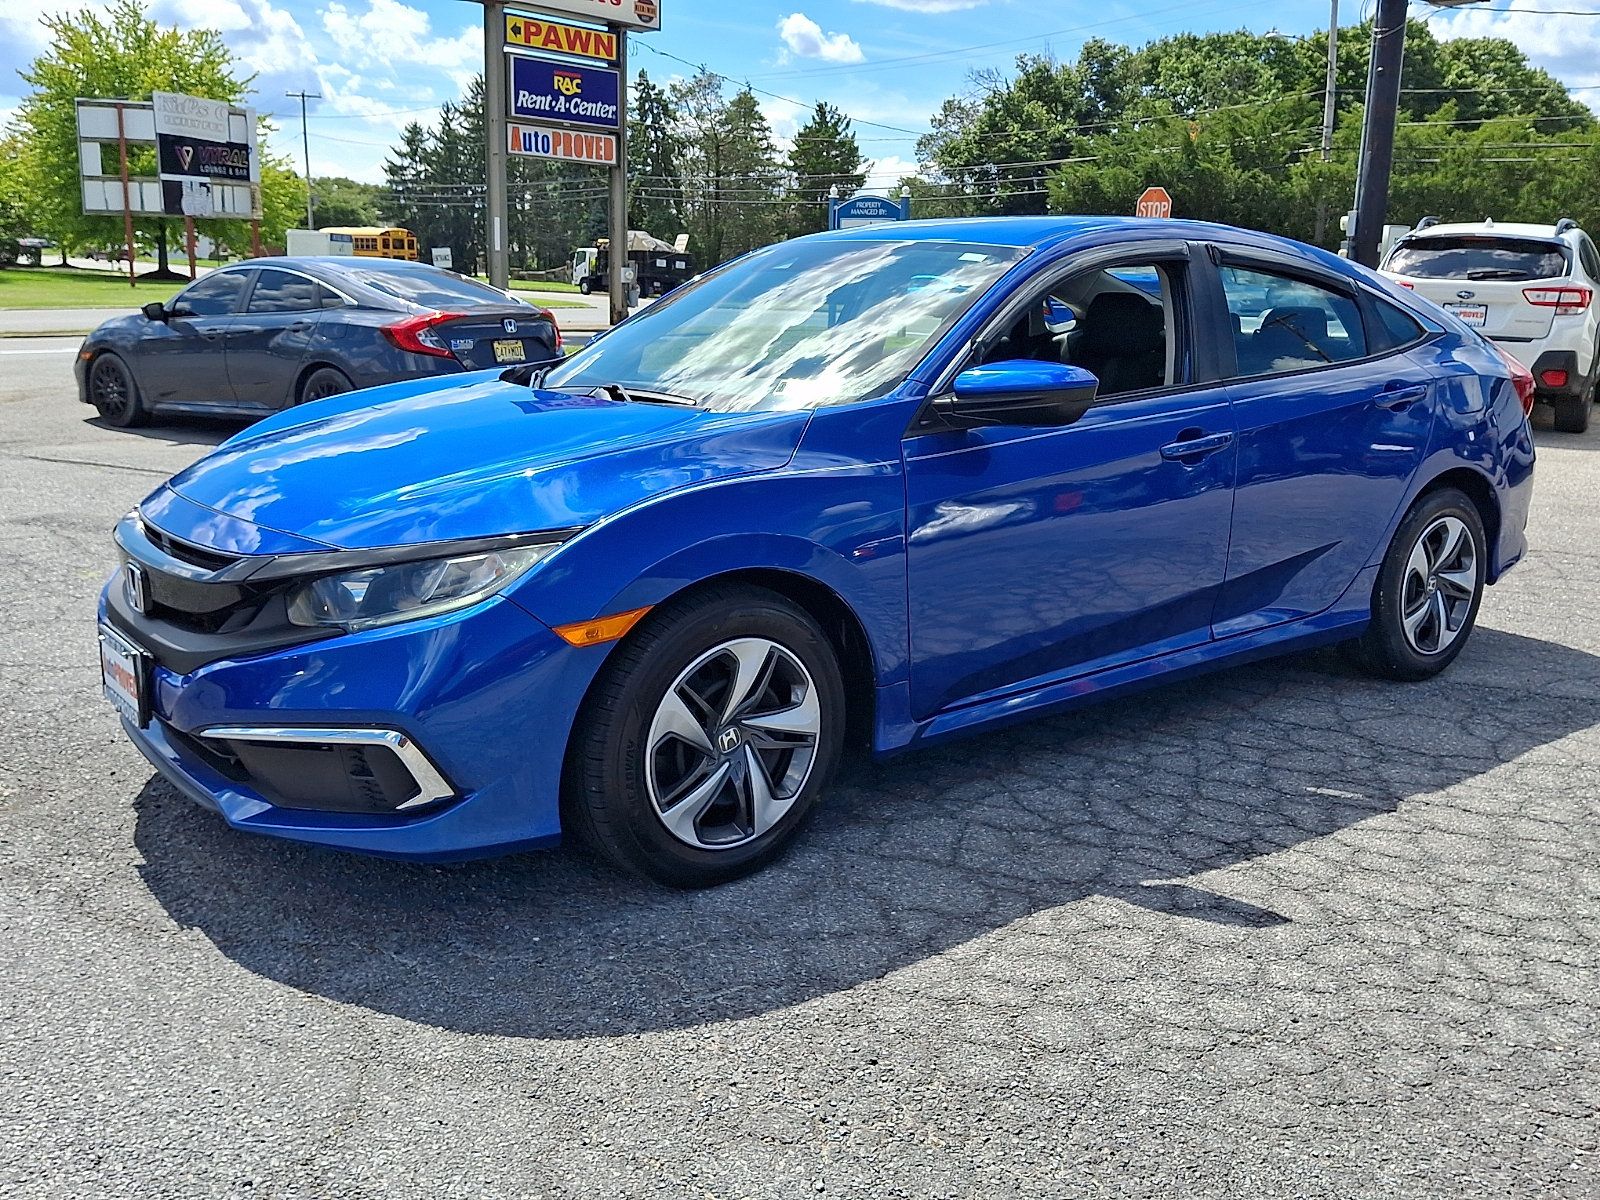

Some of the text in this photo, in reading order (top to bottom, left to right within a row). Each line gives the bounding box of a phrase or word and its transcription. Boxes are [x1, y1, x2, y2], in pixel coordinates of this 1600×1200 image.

[523, 20, 614, 58] PAWN
[553, 75, 582, 95] RAC
[1140, 201, 1168, 218] STOP
